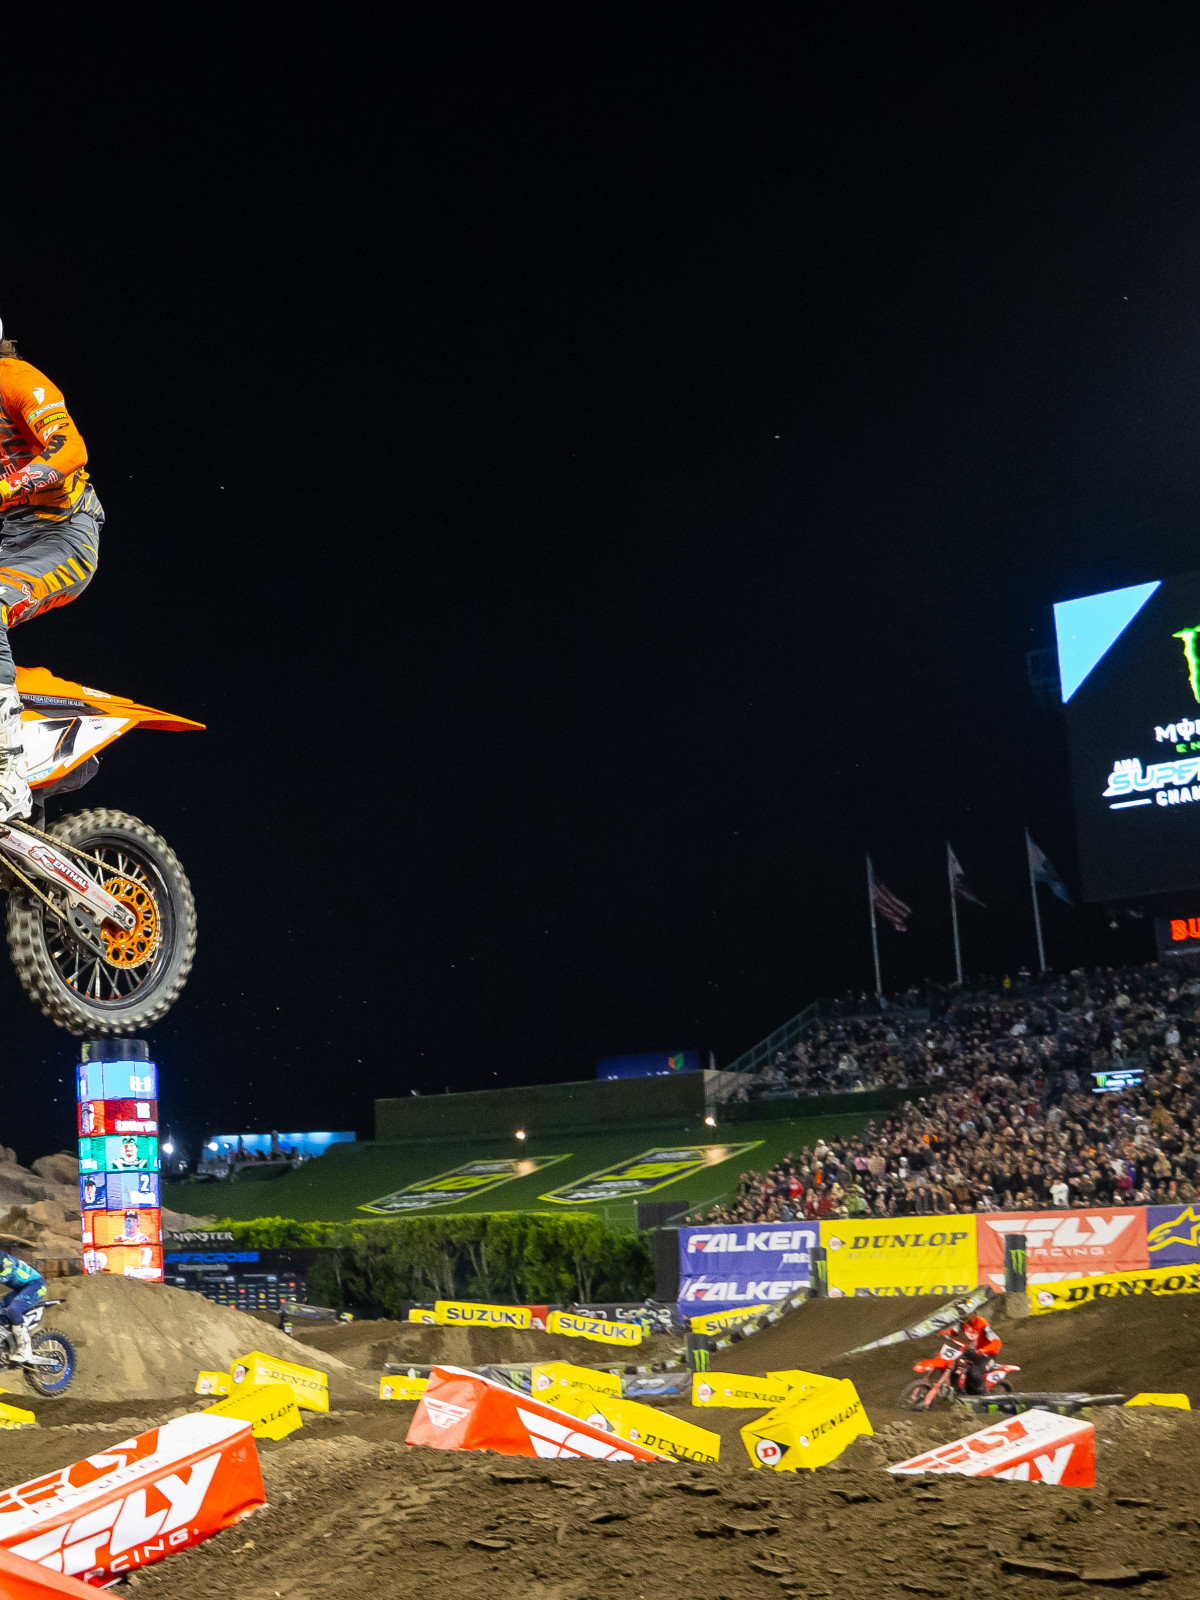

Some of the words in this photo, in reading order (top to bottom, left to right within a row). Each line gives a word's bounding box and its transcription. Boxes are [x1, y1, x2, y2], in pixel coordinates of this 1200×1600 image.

[140, 1174, 150, 1191] 2
[173, 1231, 235, 1243] MONSTER
[687, 1230, 817, 1254] FALKEN
[850, 1232, 968, 1249] DUNLOP
[446, 1308, 525, 1326] SUZUKI
[559, 1317, 635, 1340] SUZUKI
[734, 1389, 786, 1403] DUNLOP
[811, 1401, 862, 1440] DUNLOP
[761, 1446, 777, 1459] D
[7, 1452, 223, 1576] FLY
